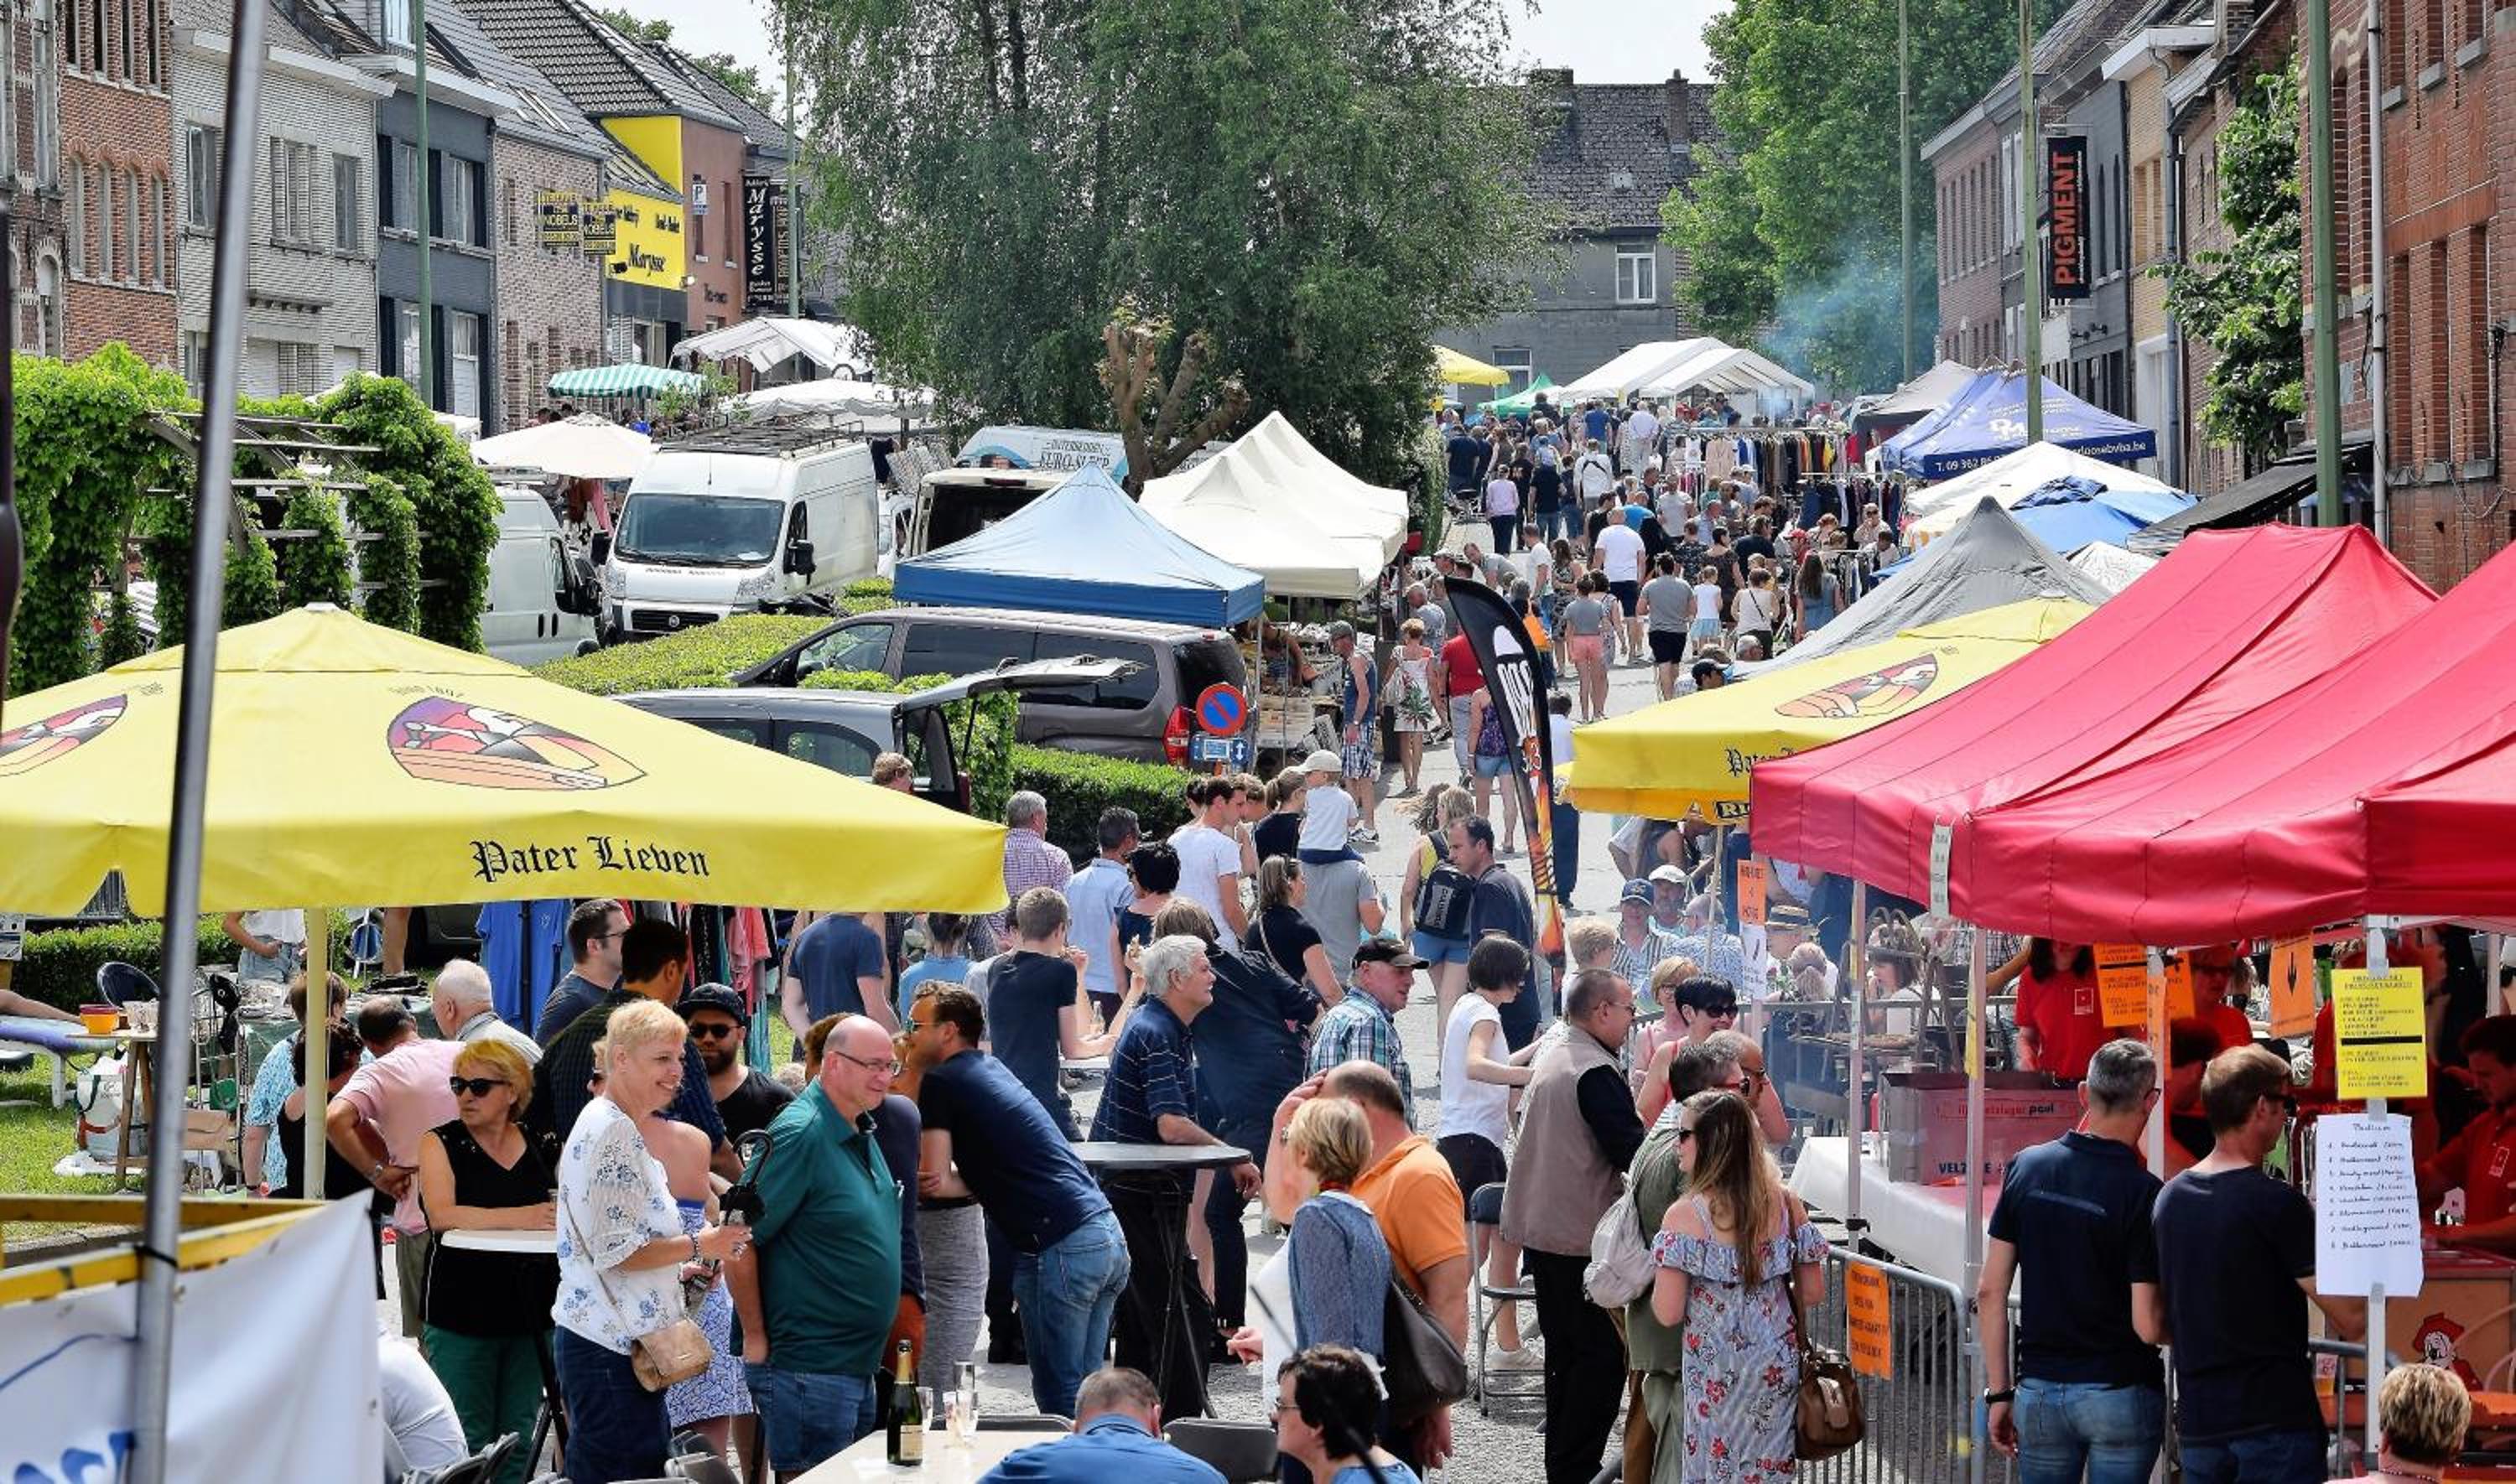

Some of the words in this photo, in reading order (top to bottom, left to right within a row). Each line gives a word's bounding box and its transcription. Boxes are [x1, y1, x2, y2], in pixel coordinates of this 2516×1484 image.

[746, 187, 767, 276] Marysse
[2053, 151, 2076, 284] PIGMENT
[469, 839, 578, 883] Pater
[586, 836, 710, 877] Lieven
